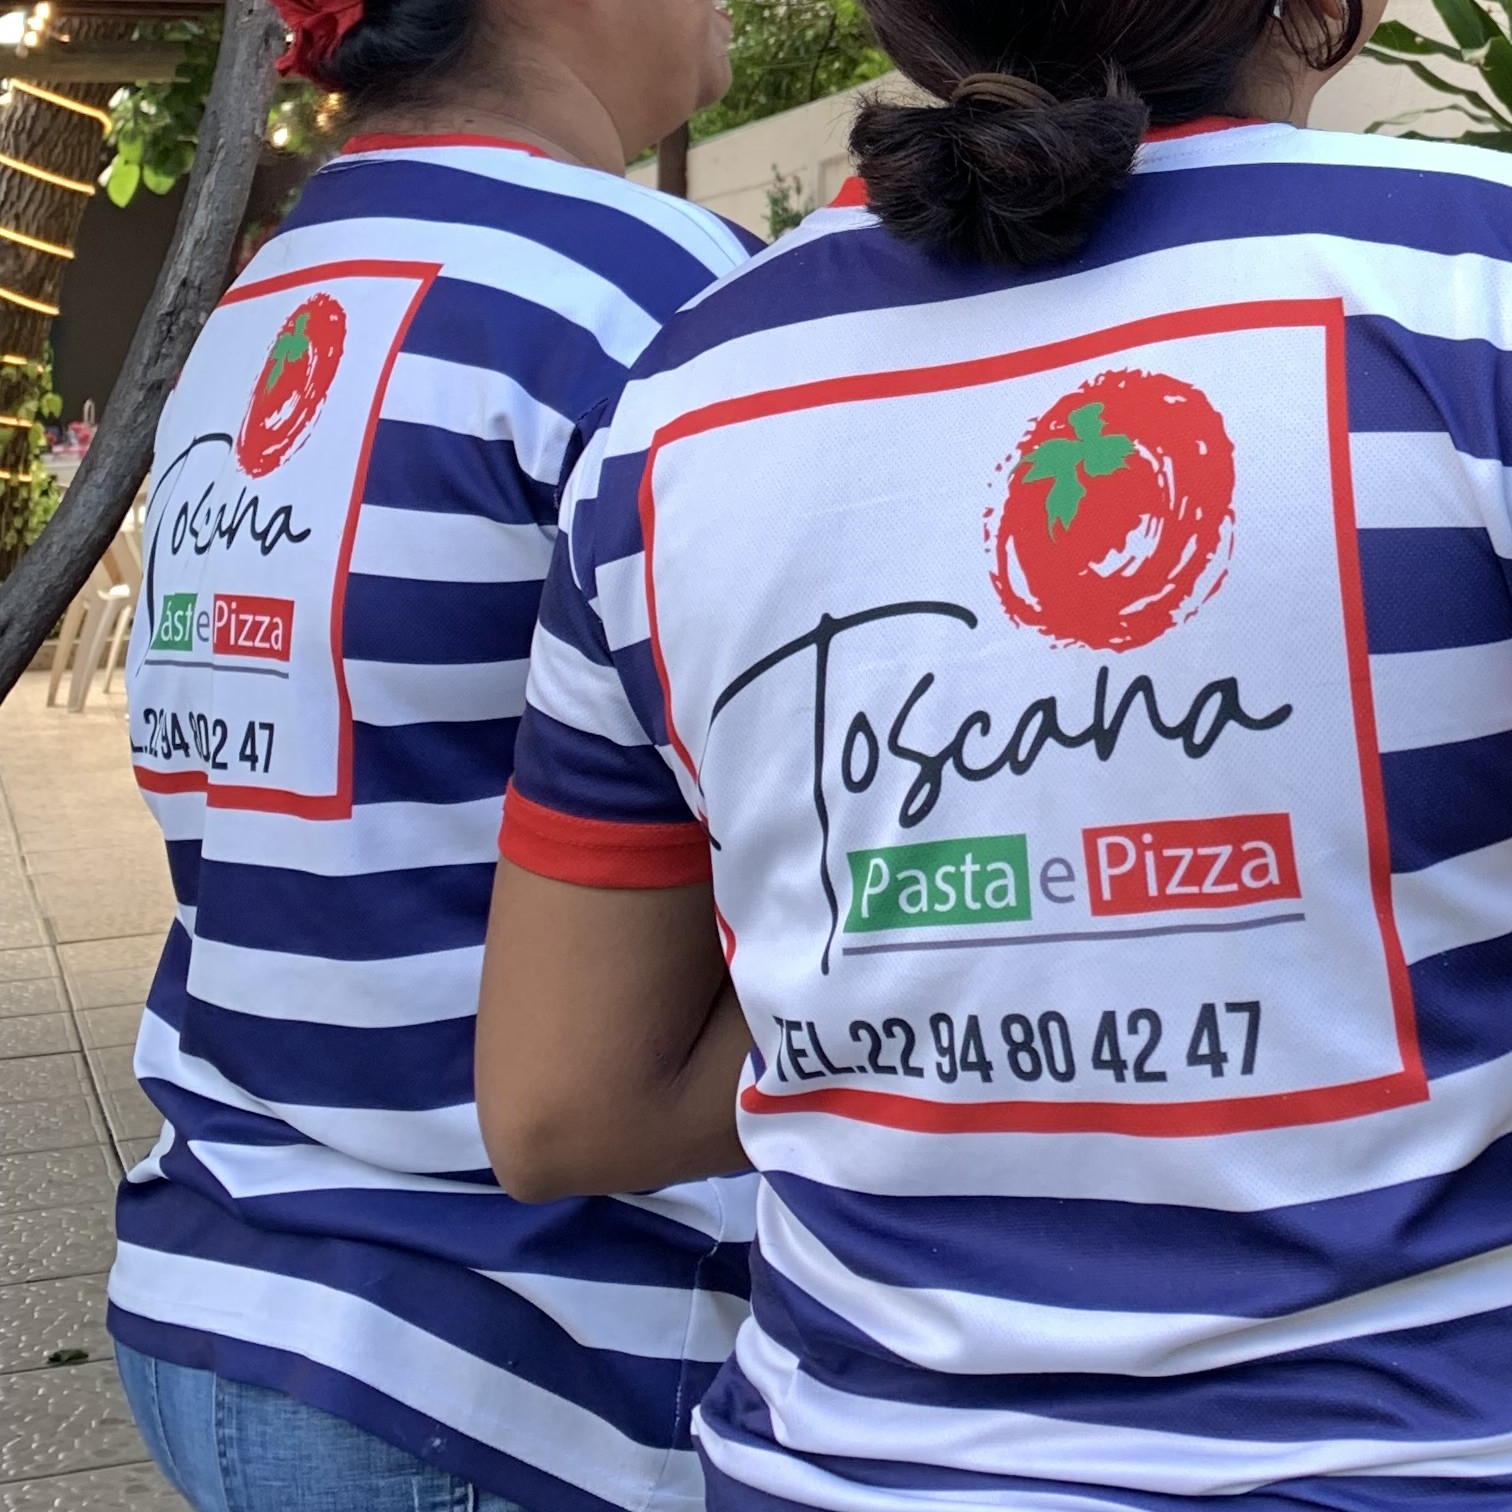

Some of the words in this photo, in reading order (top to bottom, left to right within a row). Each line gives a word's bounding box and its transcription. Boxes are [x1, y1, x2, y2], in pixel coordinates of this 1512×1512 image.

[213, 599, 283, 652] Pizza
[238, 719, 275, 774] 47
[697, 600, 1293, 976] Toscana
[859, 858, 1018, 919] Pasta
[1038, 855, 1077, 905] e
[1094, 832, 1281, 902] Pizza
[929, 1011, 994, 1084] 94
[999, 1009, 1077, 1084] 80
[1091, 1007, 1168, 1084] 42
[1185, 999, 1262, 1078] 47
